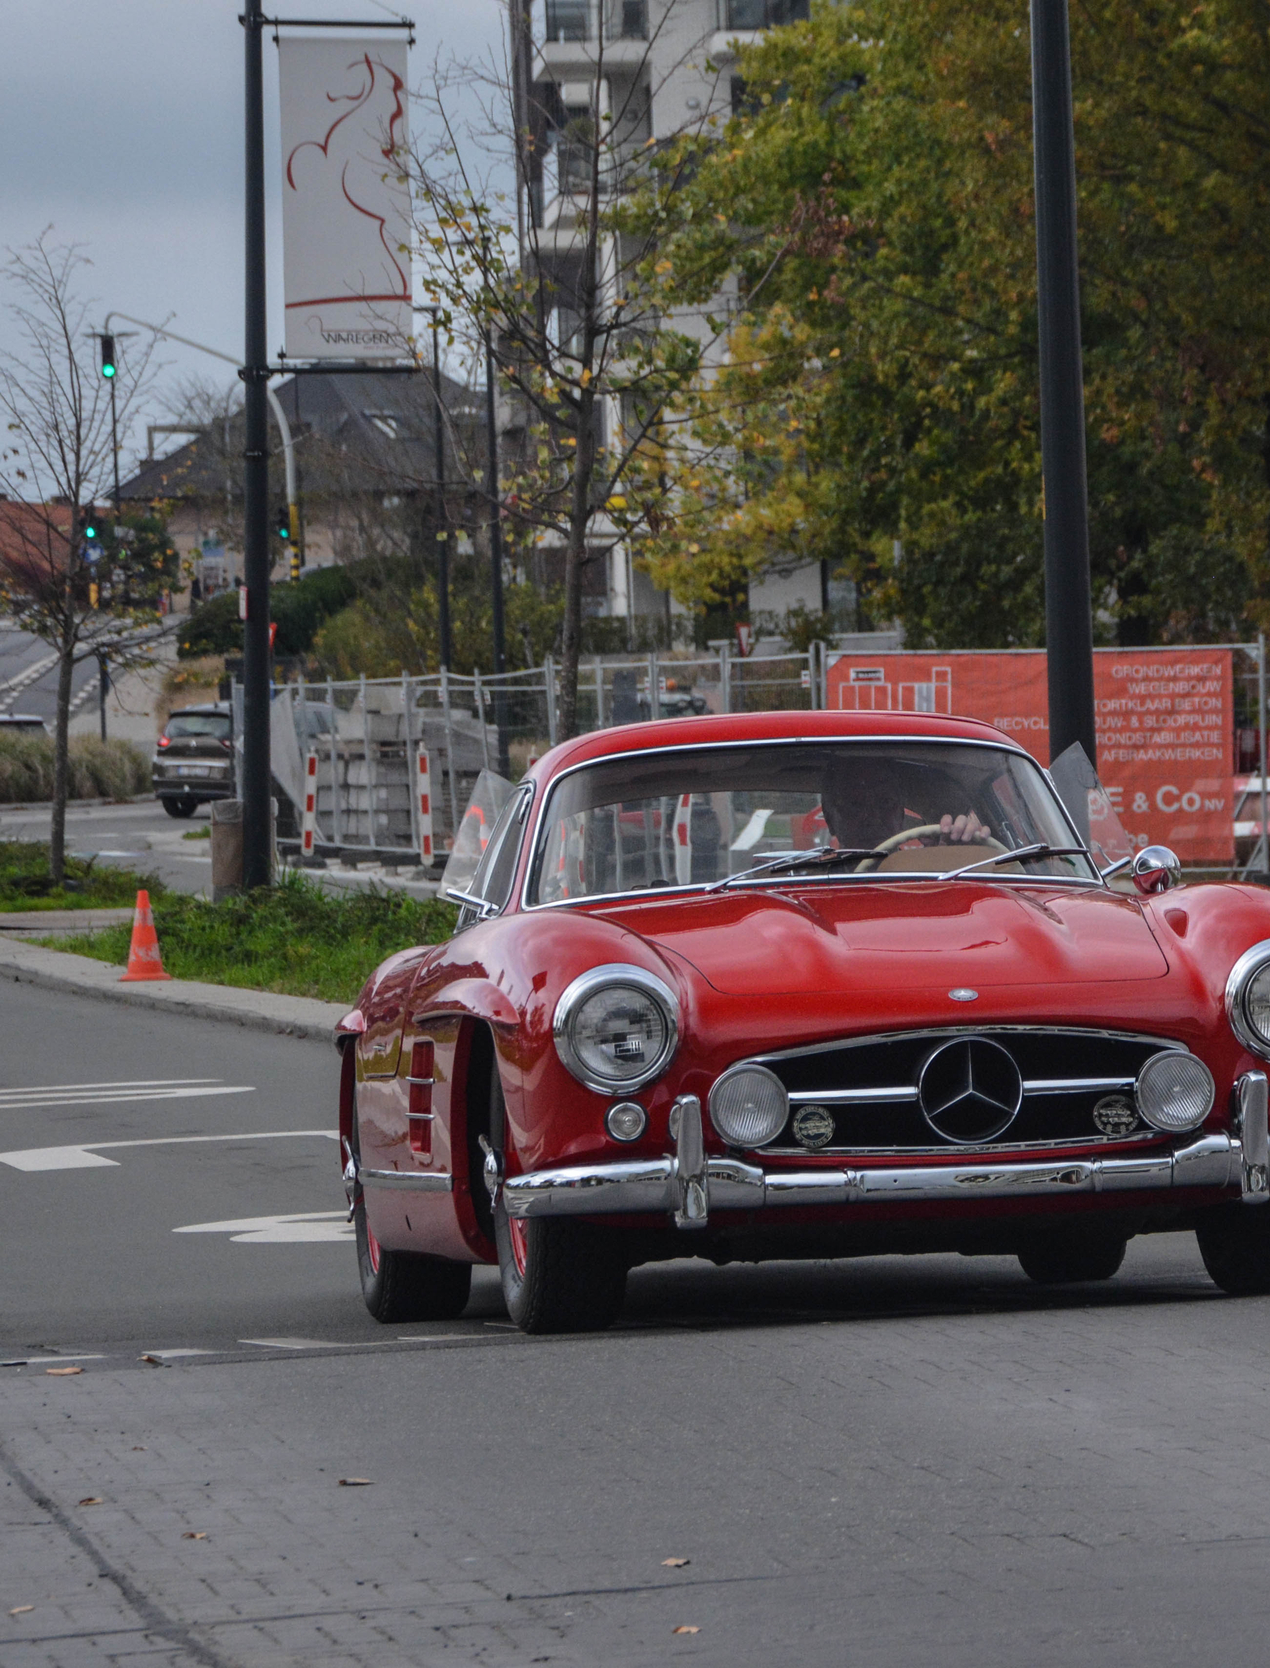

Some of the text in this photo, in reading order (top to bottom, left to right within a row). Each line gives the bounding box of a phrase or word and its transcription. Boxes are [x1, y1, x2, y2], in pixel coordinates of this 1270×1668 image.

[1112, 663, 1222, 678] GRONDWERKEN
[1127, 681, 1222, 695] WEGENBOUW
[1094, 696, 1222, 712] TORTKLAAR BETON
[993, 716, 1049, 730] RECYCL
[1130, 715, 1139, 728] &
[1144, 713, 1222, 728] SLOOPPUIN
[1096, 730, 1222, 746] RONDSTABILISATIE
[1102, 747, 1223, 761] AFBRAAKWERKEN
[1132, 792, 1150, 813] &
[1204, 798, 1225, 811] NV
